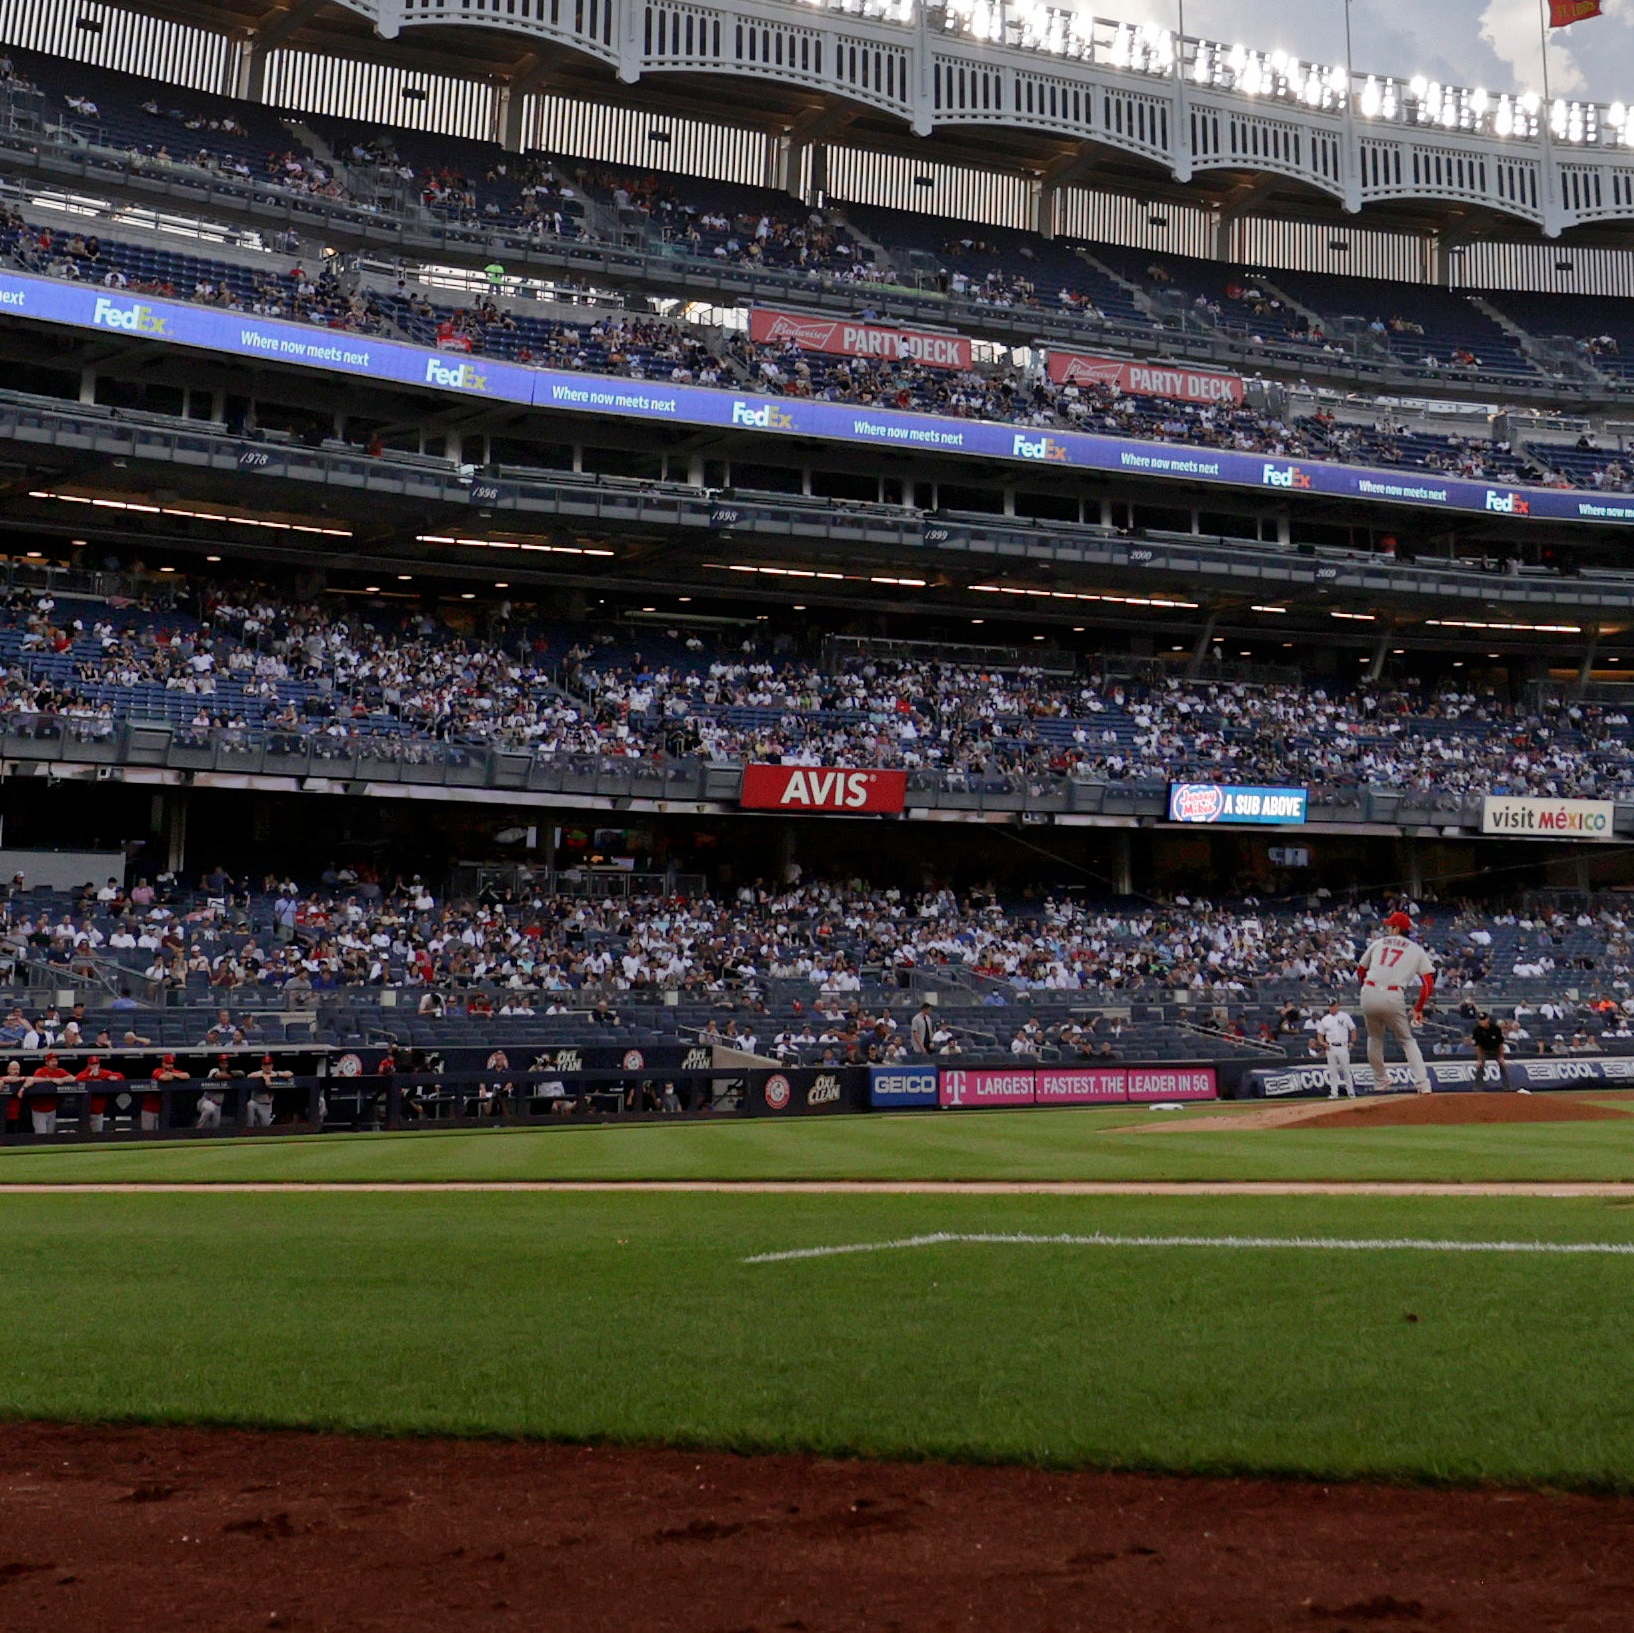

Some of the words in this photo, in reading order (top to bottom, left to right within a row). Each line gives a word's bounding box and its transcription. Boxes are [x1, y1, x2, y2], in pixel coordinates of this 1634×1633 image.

[94, 299, 165, 335] FedEx
[773, 323, 830, 343] Budweiser
[242, 331, 278, 350] Where
[280, 341, 305, 354] now
[307, 346, 342, 361] meets
[343, 352, 369, 366] next
[843, 328, 900, 358] PARTY
[909, 340, 960, 365] DECK
[426, 359, 488, 391] FedEx
[1130, 366, 1183, 395] PARTY
[1187, 375, 1233, 400] DECK
[553, 386, 588, 402] Where
[591, 393, 614, 405] now
[616, 396, 649, 409] meets
[651, 400, 675, 412] next
[732, 402, 793, 430] FedEx
[855, 421, 886, 436] Where
[888, 428, 908, 438] now
[910, 430, 939, 442] meets
[941, 433, 963, 445] next
[1013, 435, 1066, 461] FedEx
[1121, 453, 1150, 467] Where
[1151, 458, 1170, 469] now
[1171, 461, 1197, 472] meets
[1199, 463, 1218, 475] next
[1263, 464, 1310, 488] FedEx
[1359, 480, 1385, 493] Where
[1386, 486, 1402, 495] now
[1403, 488, 1427, 498] meets
[1429, 490, 1447, 501] next
[1486, 490, 1529, 514] FedEx
[780, 771, 868, 806] AVIS
[1225, 796, 1235, 813] A
[1236, 796, 1260, 816] SUB
[1263, 797, 1303, 818] ABOVE
[1492, 806, 1534, 829] visit
[1379, 948, 1404, 967] 17
[815, 1074, 837, 1088] OXI
[1557, 1063, 1599, 1079] COOL
[807, 1084, 841, 1105] CLEAN
[875, 1075, 935, 1093] GEICO
[946, 1070, 966, 1105] T
[977, 1077, 1040, 1095] LARGEST.
[1044, 1076, 1099, 1093] FASTEST.
[1102, 1075, 1125, 1092] THE
[1128, 1075, 1176, 1091] LEADER
[1178, 1075, 1191, 1090] IN
[1193, 1075, 1208, 1090] 5G
